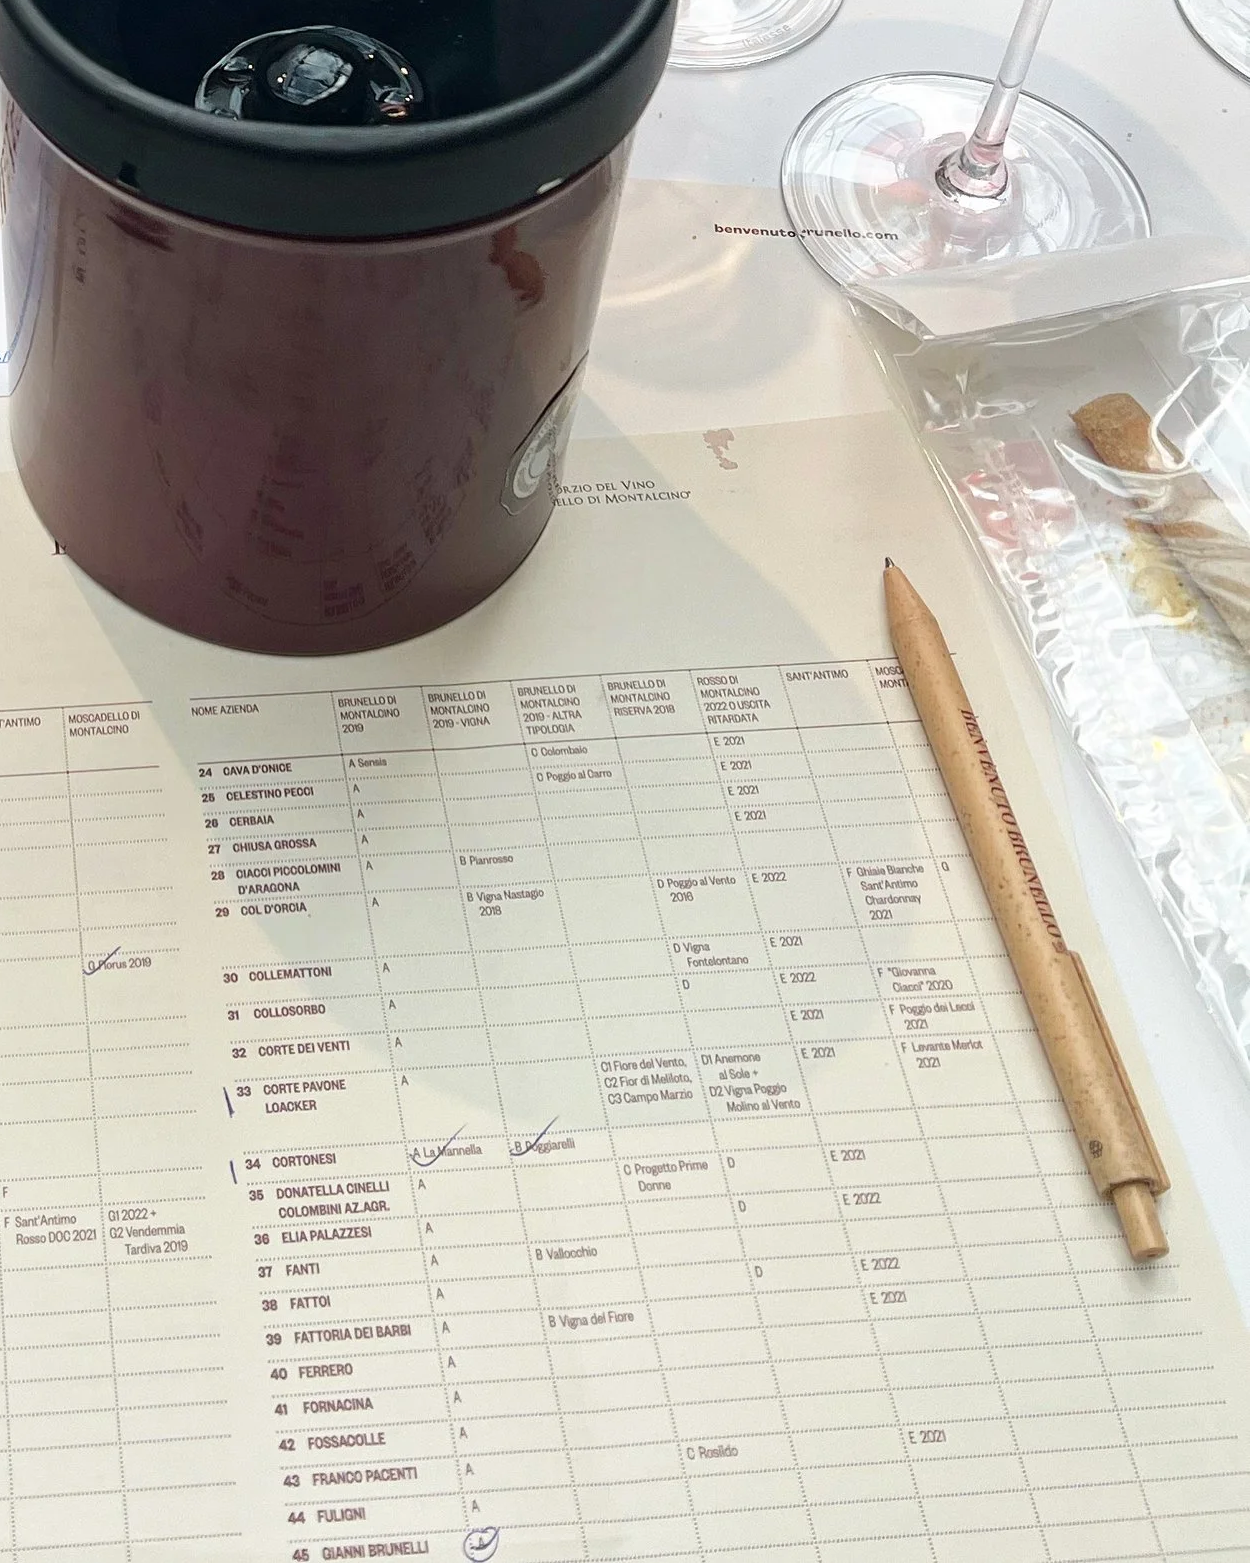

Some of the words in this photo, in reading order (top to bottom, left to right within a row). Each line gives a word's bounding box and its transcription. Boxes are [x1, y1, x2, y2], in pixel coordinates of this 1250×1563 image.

[596, 481, 618, 492] DEL
[68, 711, 128, 726] MOSCADELLO
[130, 710, 140, 721] DI
[190, 706, 218, 717] NOME
[219, 703, 259, 715] AZIENDA
[222, 764, 248, 776] CAVA
[250, 762, 293, 775] D'ONICE
[226, 788, 281, 802] CELESTINO
[283, 786, 315, 798] PECCI
[229, 814, 275, 827] CERBAIA
[232, 840, 272, 853] CHIUSA
[274, 838, 317, 851] GROSSA
[236, 866, 270, 879] CIACCI
[272, 863, 341, 877] PICCOLOMINI
[238, 882, 300, 895] D'ARAGONA
[476, 890, 502, 904] Vigna
[240, 904, 261, 916] COL
[263, 902, 307, 914] D'ORCIA
[223, 973, 238, 984] 30
[249, 966, 332, 982] COLLEMATTONI
[253, 1004, 326, 1019] COLLOSORBO
[258, 1043, 295, 1057] CORTE
[297, 1042, 315, 1054] DEI
[317, 1039, 350, 1053] VENTI
[236, 1086, 252, 1097] 33
[263, 1082, 300, 1096] CORTE
[302, 1079, 346, 1093] PAVONE
[265, 1099, 317, 1114] LOACKER
[272, 1152, 337, 1168] CORTONESI
[276, 1183, 345, 1199] DONATELLA
[346, 1181, 390, 1194] CINELLI
[278, 1202, 342, 1219] COLOMBINI
[14, 1213, 77, 1230] Sant'Antimo
[281, 1230, 308, 1244] ELIA
[309, 1226, 372, 1242] PALAZZESI
[163, 1240, 189, 1254] 2019
[285, 1263, 320, 1277] FANTI
[290, 1296, 332, 1310] FATTOI
[294, 1328, 352, 1344] FATTORIA
[354, 1326, 375, 1339] DEI
[377, 1324, 412, 1338] BARBI
[298, 1363, 354, 1378] FERRERO
[303, 1398, 373, 1414] FORNACINA
[307, 1432, 386, 1449] FOSSACOLLE
[312, 1470, 363, 1487] FRANCO
[366, 1466, 418, 1483] PACENTI
[317, 1507, 366, 1523] FULIGNI
[368, 1540, 430, 1558] BRUNELLI
